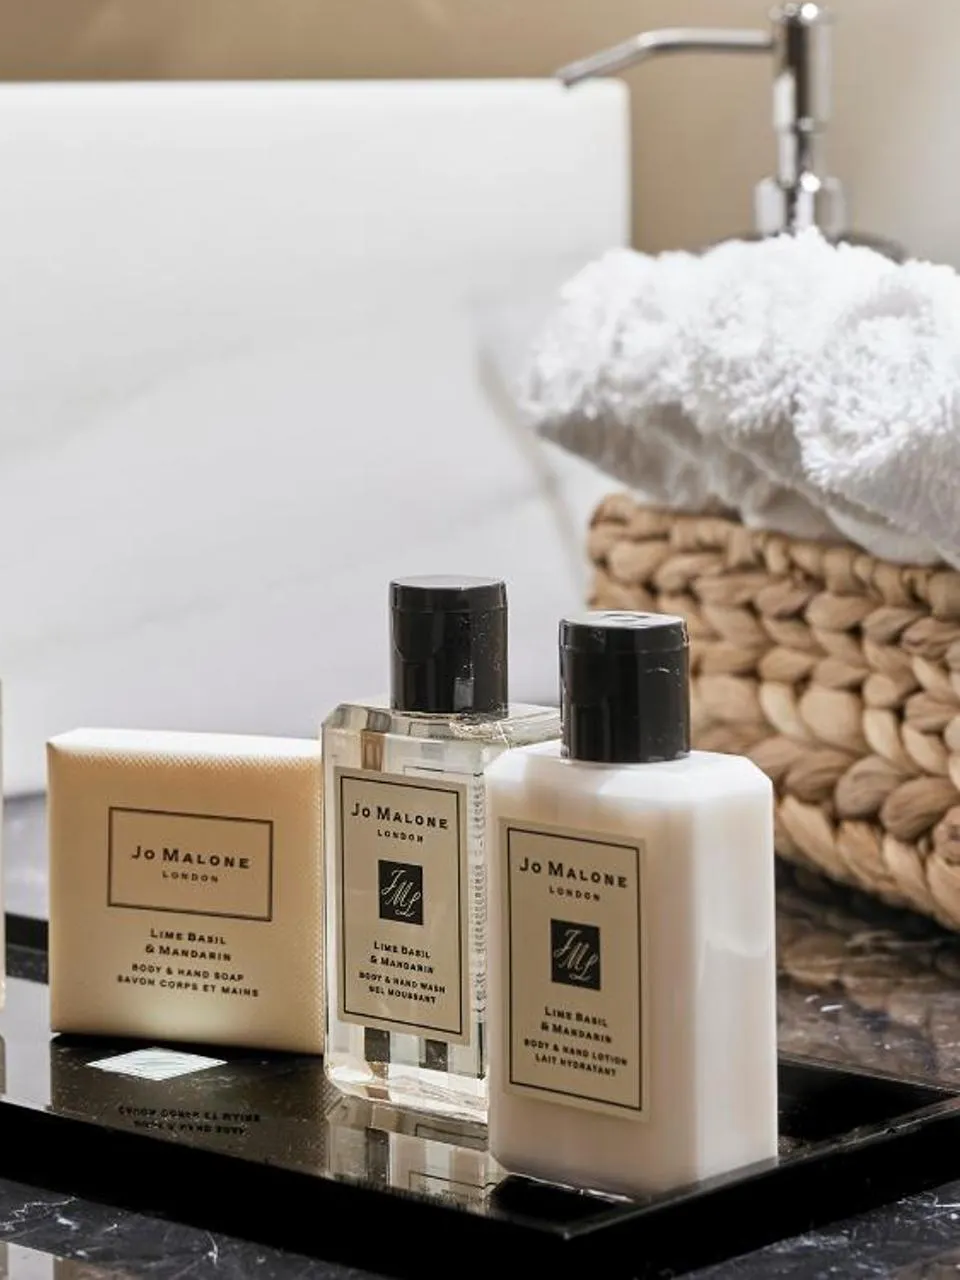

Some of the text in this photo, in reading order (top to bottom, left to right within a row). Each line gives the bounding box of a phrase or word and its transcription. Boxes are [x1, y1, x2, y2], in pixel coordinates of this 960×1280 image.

[351, 802, 448, 829] JO MALONE
[377, 829, 423, 842] LONDON
[131, 845, 250, 869] JO MALONE
[162, 870, 218, 883] LONDON
[520, 856, 628, 889] JO MALONE
[549, 885, 600, 902] LONDON
[150, 928, 226, 945] LIME BASIL
[145, 944, 232, 961] & MANDARIN
[374, 940, 431, 959] LIME BASIL
[132, 963, 244, 982] BODY & HAND SOAP
[370, 955, 434, 974] & MANDARIN
[117, 974, 259, 998] SAVON CORPS ET MAINS
[359, 971, 445, 994] BODY & HAND WASH
[388, 989, 436, 1004] MOUSSANT
[545, 1006, 607, 1028] LIME BASIL
[541, 1021, 612, 1043] & MANDARIN
[524, 1038, 628, 1066] BODY & HAND LOTION
[535, 1053, 557, 1065] LAIT
